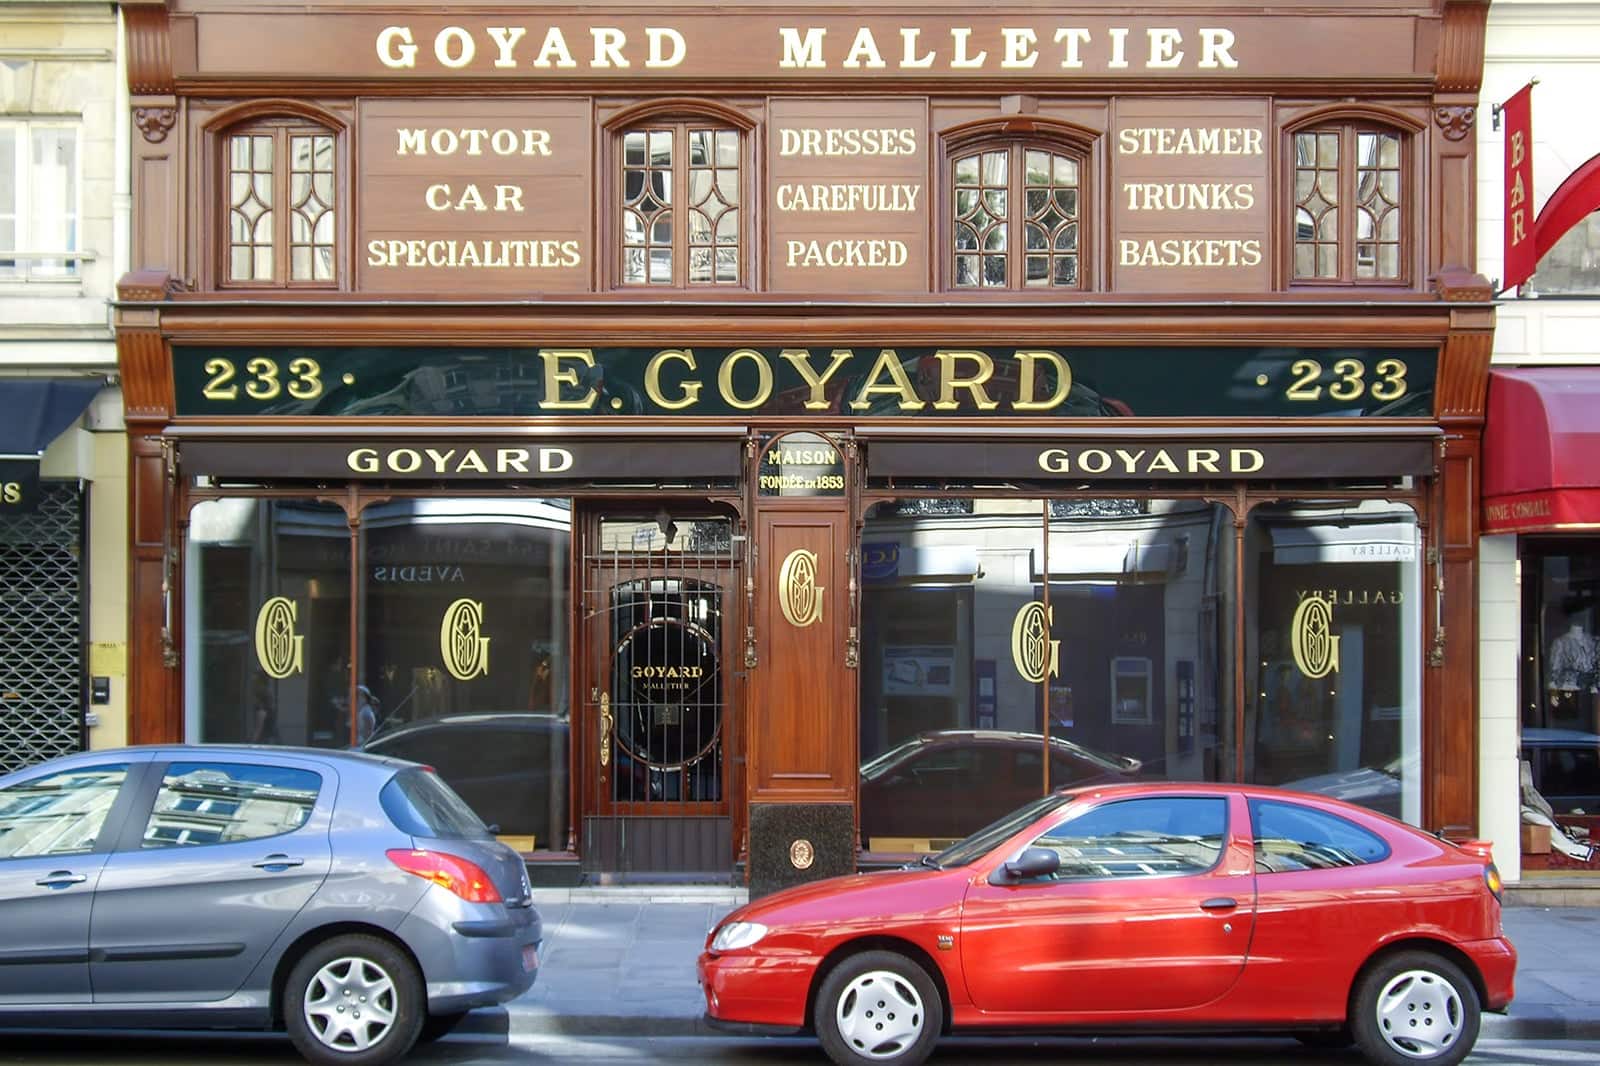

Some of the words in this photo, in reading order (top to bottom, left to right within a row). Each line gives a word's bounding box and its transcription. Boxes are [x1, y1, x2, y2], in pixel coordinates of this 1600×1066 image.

[375, 26, 688, 69] GOYARD
[778, 24, 1239, 70] MALLETIER
[396, 127, 553, 158] MOTOR
[778, 127, 917, 158] DRESSES
[1118, 127, 1265, 157] STEAMER
[425, 183, 525, 213] CAR
[776, 182, 921, 214] CAREFULLY
[1122, 182, 1257, 213] TRUNKS
[1510, 130, 1527, 247] BAR
[367, 239, 581, 268] SPECIALITIES
[785, 239, 909, 269] PACKED
[1119, 238, 1263, 268] BASKETS
[202, 357, 323, 400] 233
[537, 348, 623, 411] E.
[644, 348, 1072, 411] GOYARD
[1285, 358, 1408, 402] 233
[346, 446, 575, 474] GOYARD
[768, 451, 836, 465] MAISON
[1038, 447, 1264, 473] GOYARD
[0, 482, 21, 503] S
[759, 474, 804, 489] FONDÉE
[816, 475, 844, 489] 1853
[631, 666, 703, 678] GOYARD
